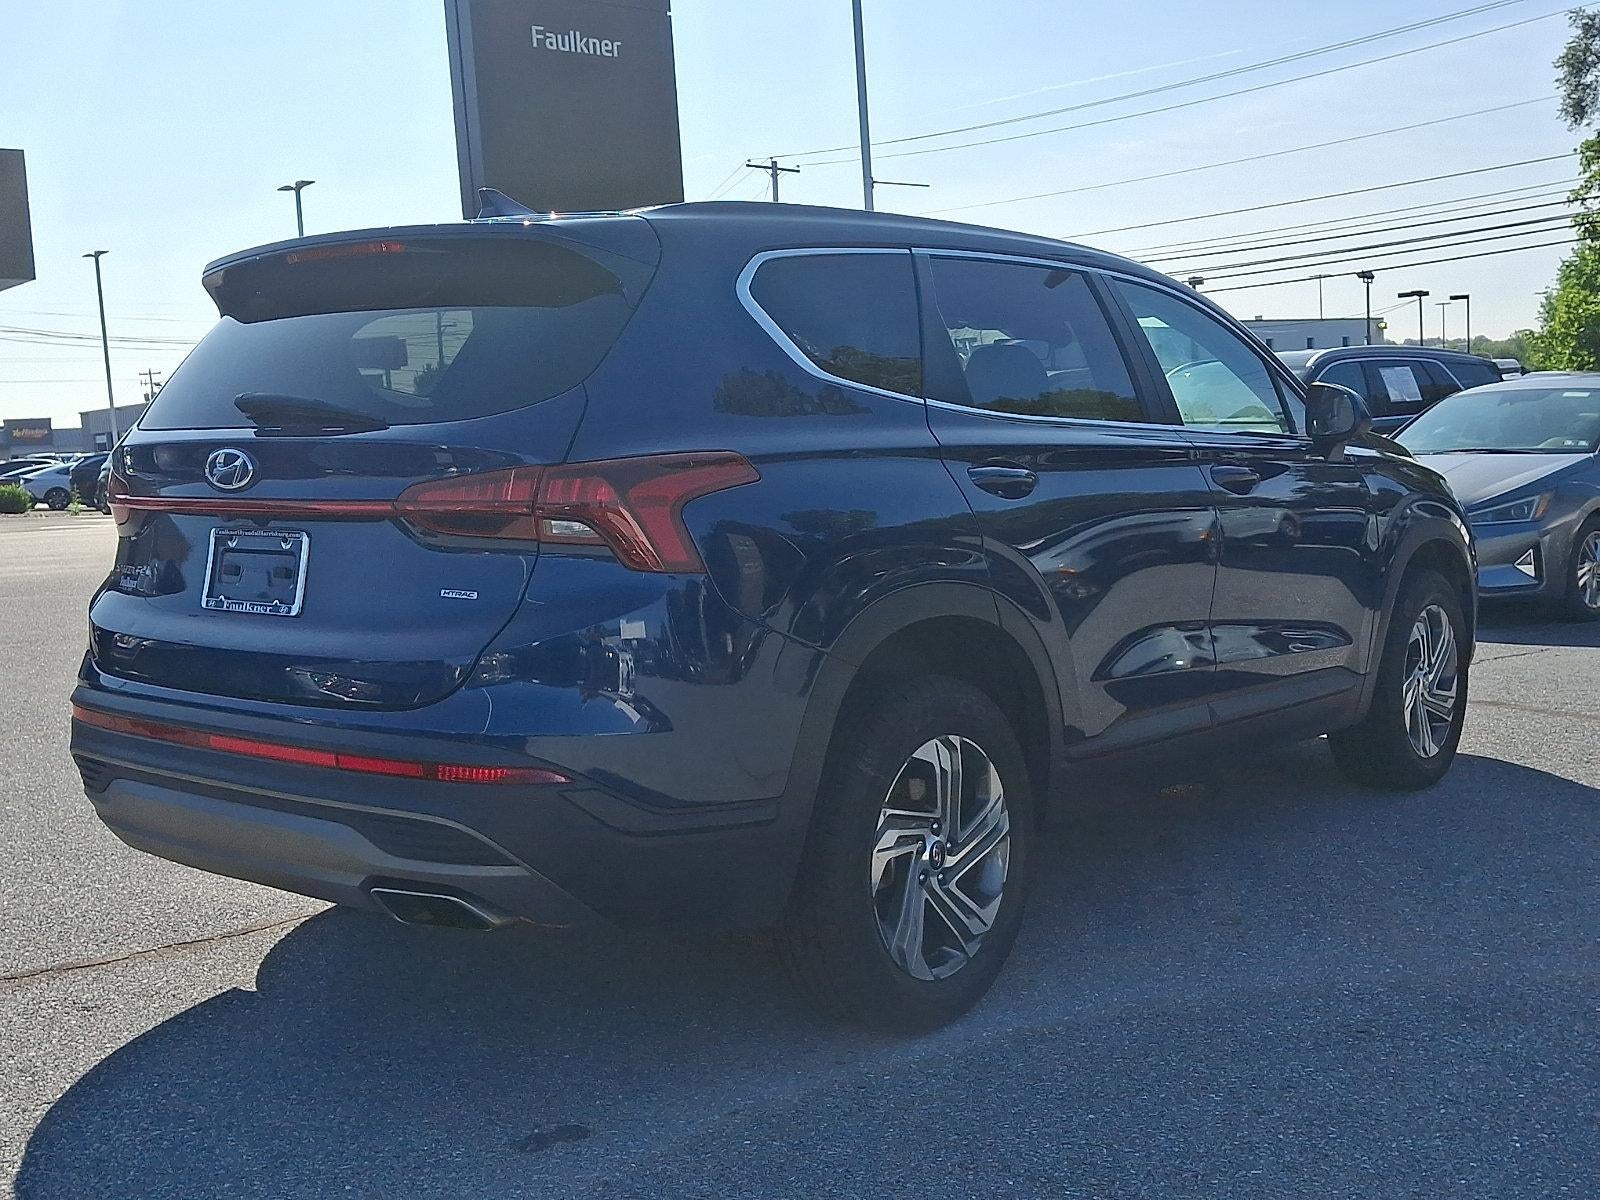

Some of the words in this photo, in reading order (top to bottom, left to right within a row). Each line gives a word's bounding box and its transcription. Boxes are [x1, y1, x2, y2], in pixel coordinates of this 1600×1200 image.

[531, 25, 622, 57] Faulkner
[442, 590, 477, 599] HTRAC
[223, 601, 273, 613] Faulkner
